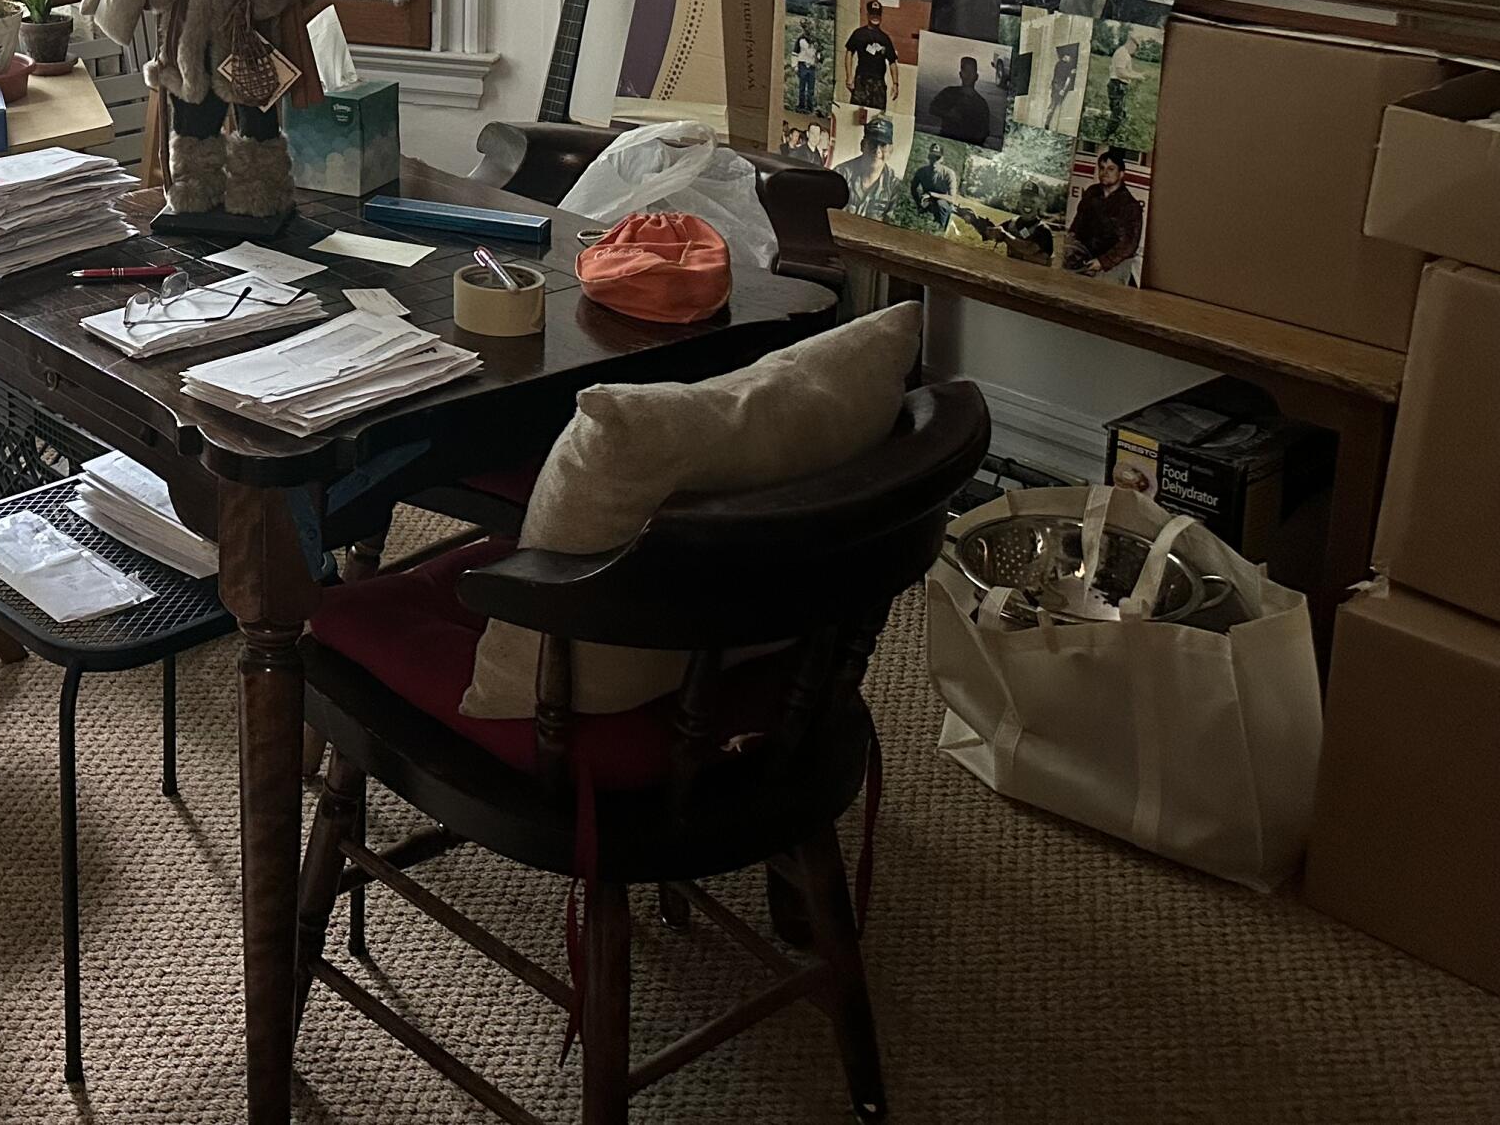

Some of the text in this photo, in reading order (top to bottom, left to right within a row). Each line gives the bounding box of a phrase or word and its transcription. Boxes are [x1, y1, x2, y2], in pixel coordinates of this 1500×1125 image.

[1117, 441, 1158, 458] PRESTO
[1162, 464, 1188, 482] Food
[1161, 477, 1219, 506] Dehydrator
